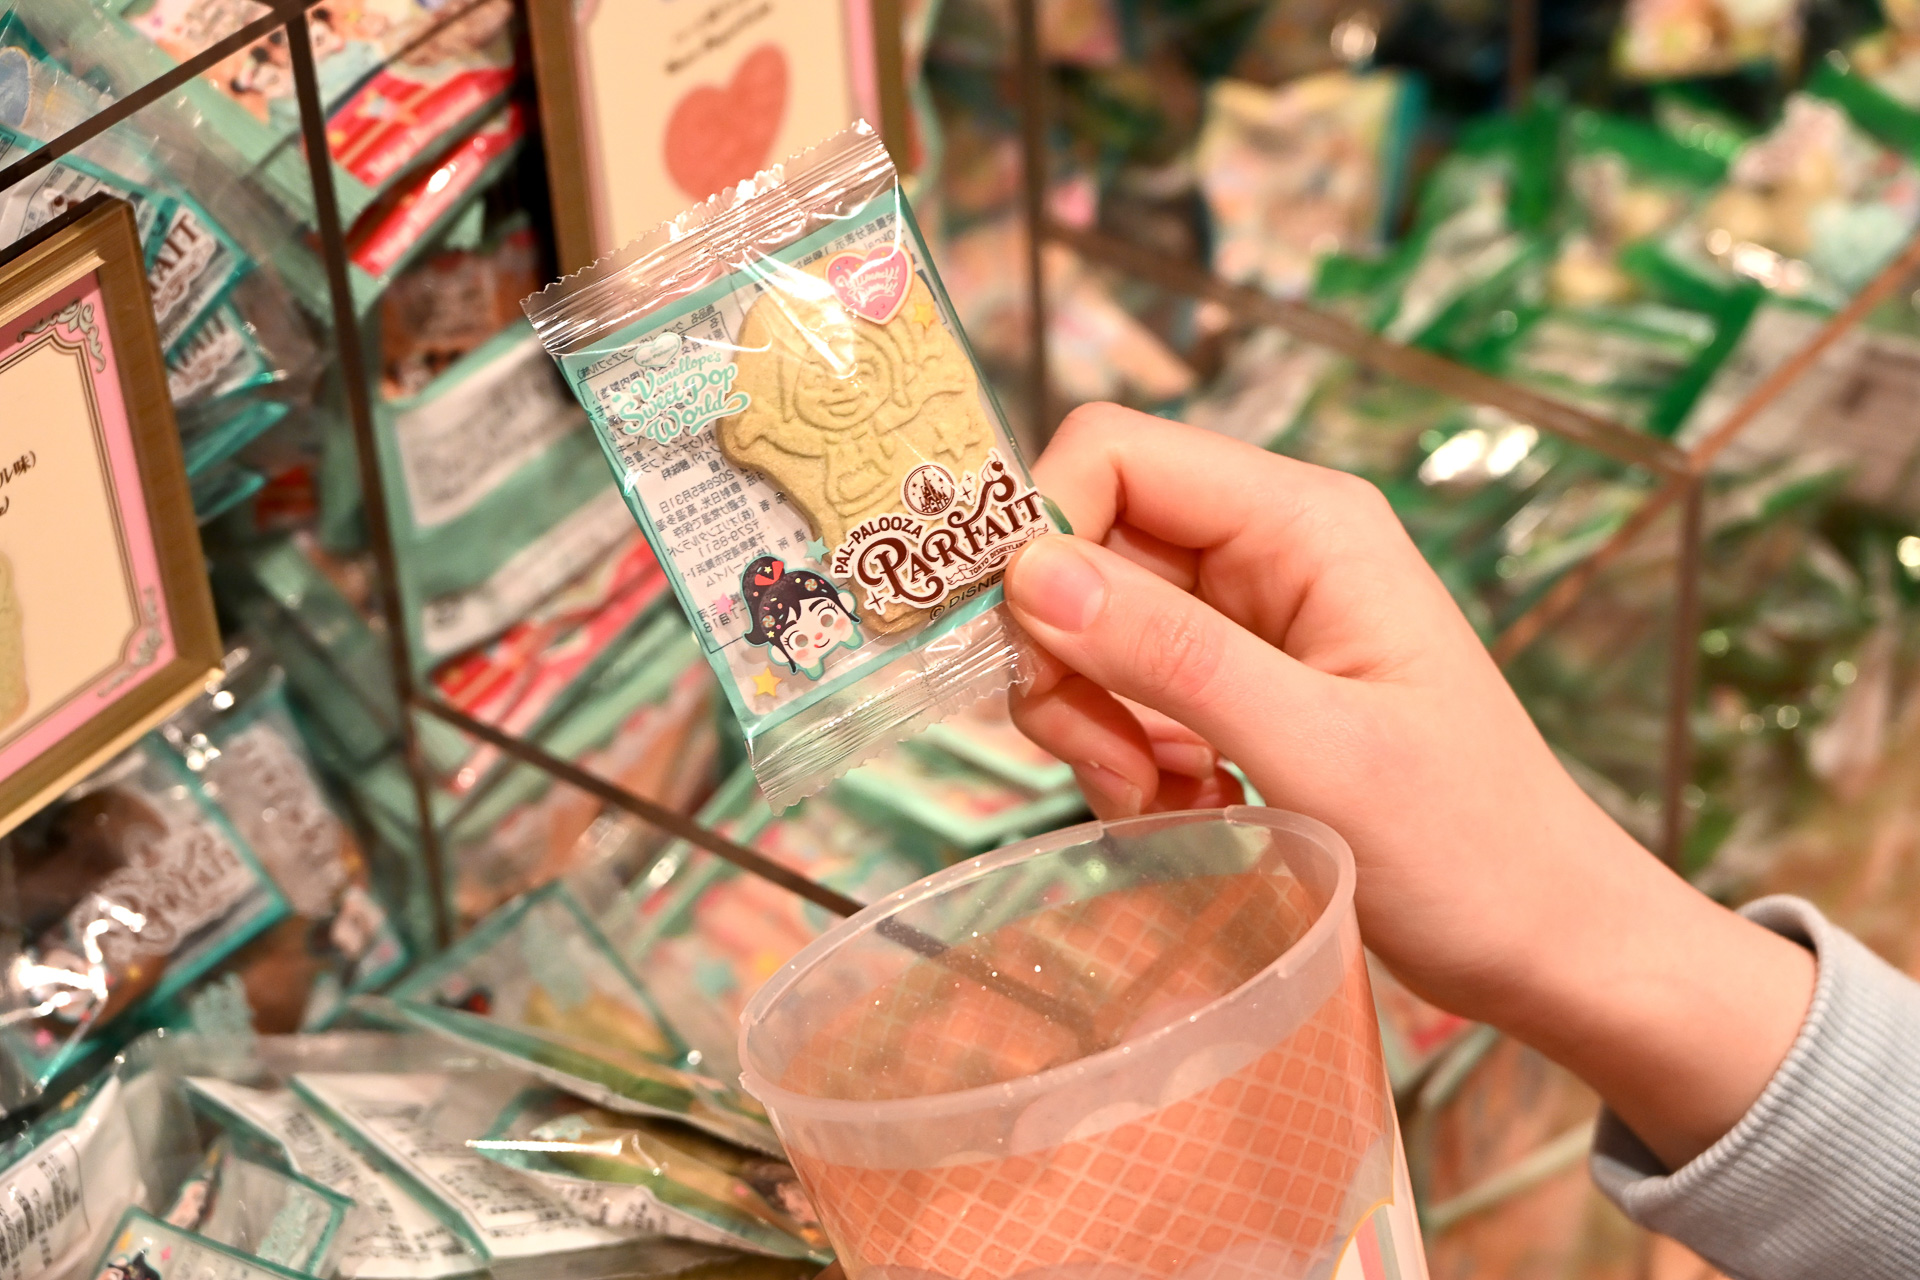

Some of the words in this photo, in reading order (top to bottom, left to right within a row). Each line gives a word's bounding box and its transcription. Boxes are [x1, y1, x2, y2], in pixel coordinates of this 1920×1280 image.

[619, 380, 684, 432] Sweet
[683, 365, 735, 404] Pop
[631, 353, 721, 399] Vanellope's
[646, 389, 747, 442] World
[833, 513, 925, 573] PAL-PALOOZA
[860, 475, 1042, 600] PARFAIT
[968, 557, 989, 575] TOKYO
